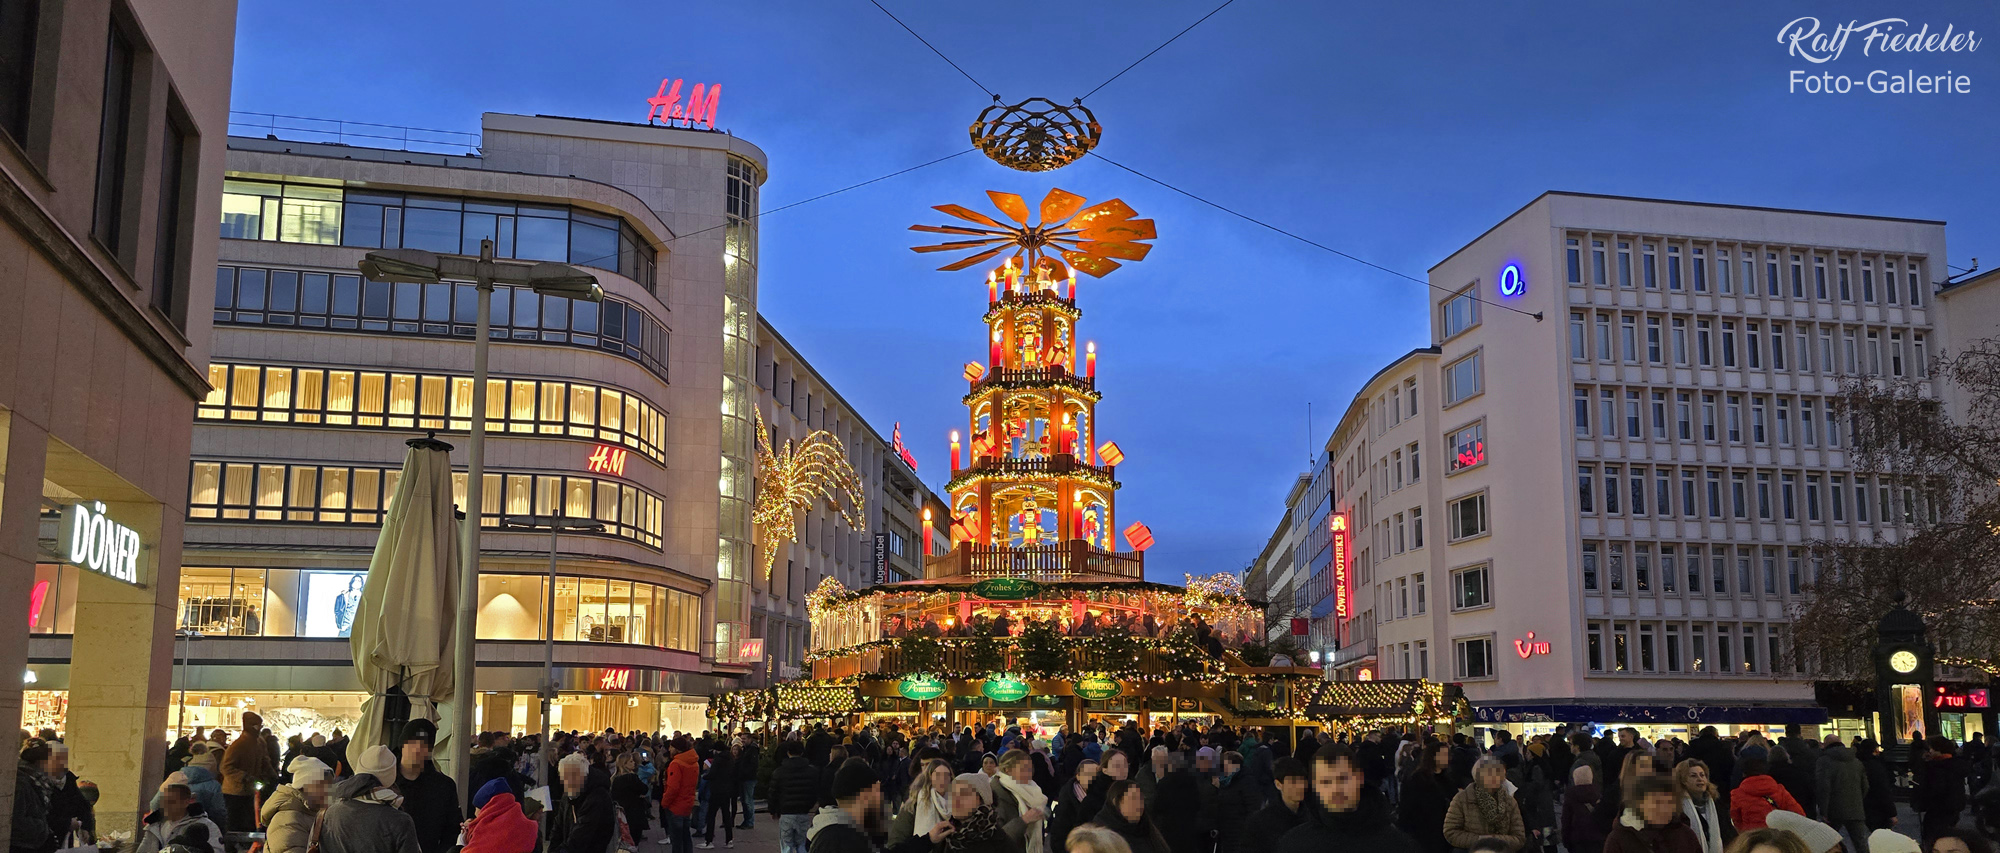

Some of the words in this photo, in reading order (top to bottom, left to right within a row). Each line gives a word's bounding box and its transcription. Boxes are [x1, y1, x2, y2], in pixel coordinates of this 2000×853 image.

[647, 78, 722, 130] H&M
[588, 445, 627, 477] H&M
[70, 500, 140, 584] DÖNER
[1335, 534, 1347, 617] LÖWEN-APOTHEKE
[981, 581, 1012, 592] Frohes
[1014, 580, 1034, 592] Fest
[740, 643, 762, 658] H&M
[1534, 641, 1551, 655] TUI
[601, 669, 629, 691] H&M
[902, 682, 942, 693] Pommes
[1945, 696, 1964, 707] TUI
